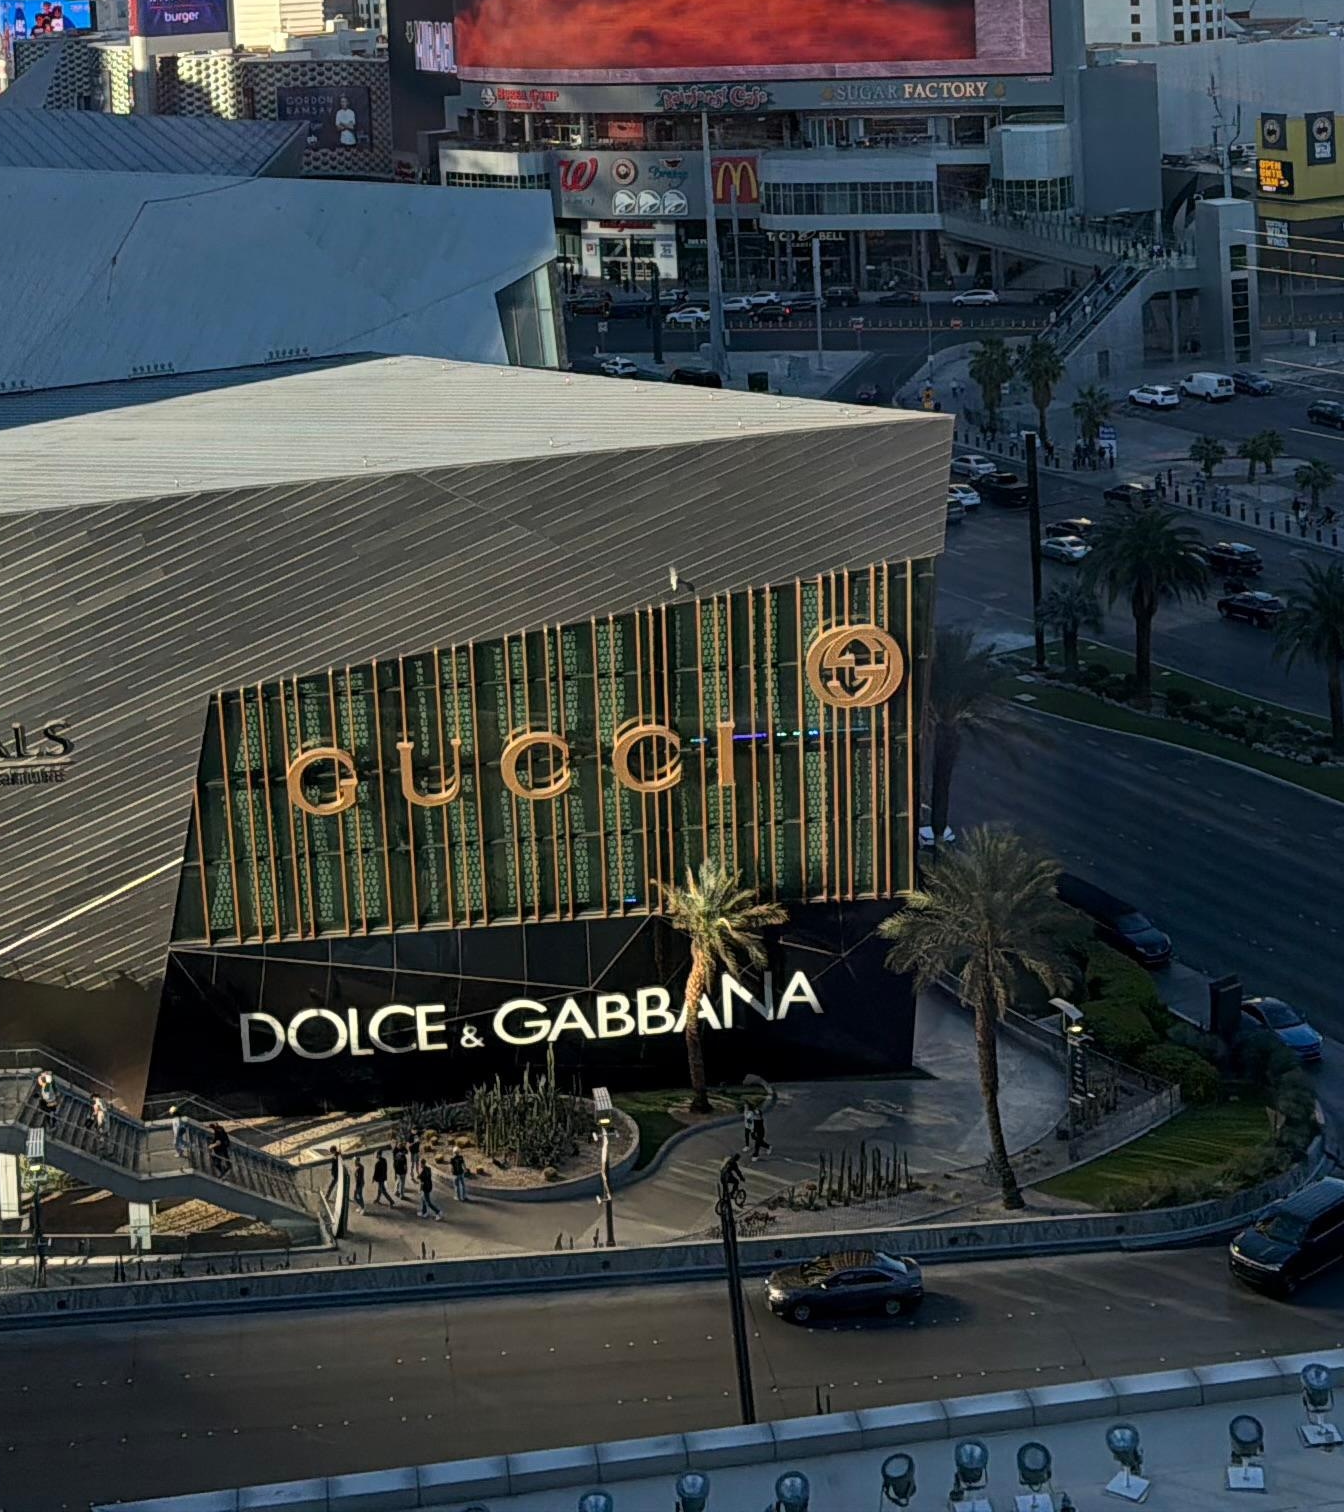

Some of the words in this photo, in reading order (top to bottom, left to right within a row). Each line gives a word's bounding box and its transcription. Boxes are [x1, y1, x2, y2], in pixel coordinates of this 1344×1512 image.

[164, 11, 199, 23] burger
[835, 85, 898, 100] SUGAR
[904, 81, 988, 99] FACTORY
[819, 231, 846, 241] BELL
[286, 715, 737, 816] GUCCI
[240, 1004, 448, 1063] DOLCE
[460, 1024, 485, 1048] &
[492, 970, 826, 1046] GABBANA
